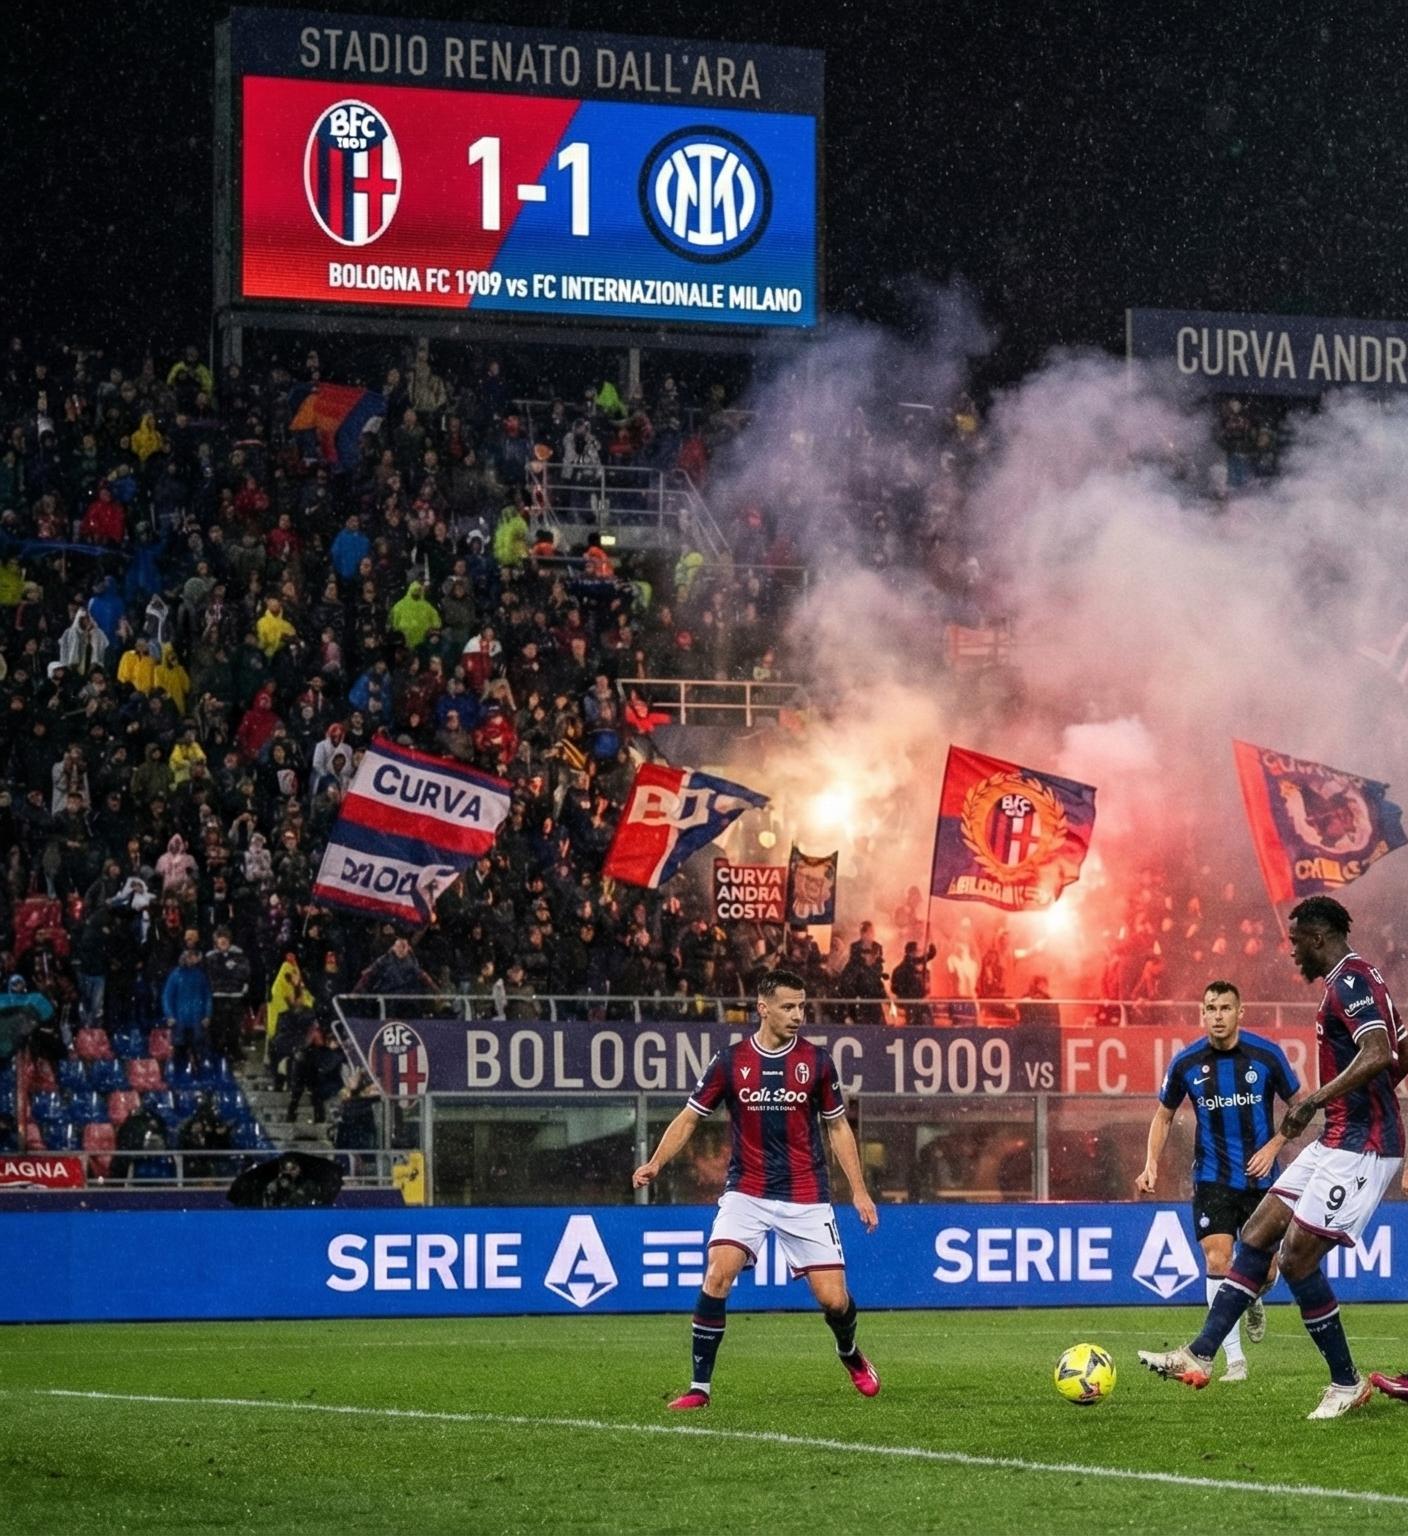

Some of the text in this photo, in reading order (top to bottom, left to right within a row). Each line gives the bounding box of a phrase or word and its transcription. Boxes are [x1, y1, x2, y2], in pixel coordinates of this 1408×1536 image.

[300, 26, 761, 99] STADIO RENATO DALL'ARA
[329, 107, 376, 138] BFC
[329, 262, 802, 312] BOLOGNA FC 1909 vs FC INTERNAZIONALE MILANO
[1176, 326, 1296, 380] CURVA
[372, 764, 481, 822] CURVA
[716, 867, 781, 884] CURVA
[717, 886, 781, 901] ANDRA
[717, 903, 778, 919] COSTA
[466, 1030, 743, 1090] BOLOGN
[886, 1038, 1010, 1094] 1909
[1066, 1038, 1127, 1094] FC
[0, 1161, 69, 1178] AGNA
[1326, 1185, 1346, 1211] 9
[326, 1233, 522, 1292] SERIE
[934, 1226, 1113, 1284] SERIE
